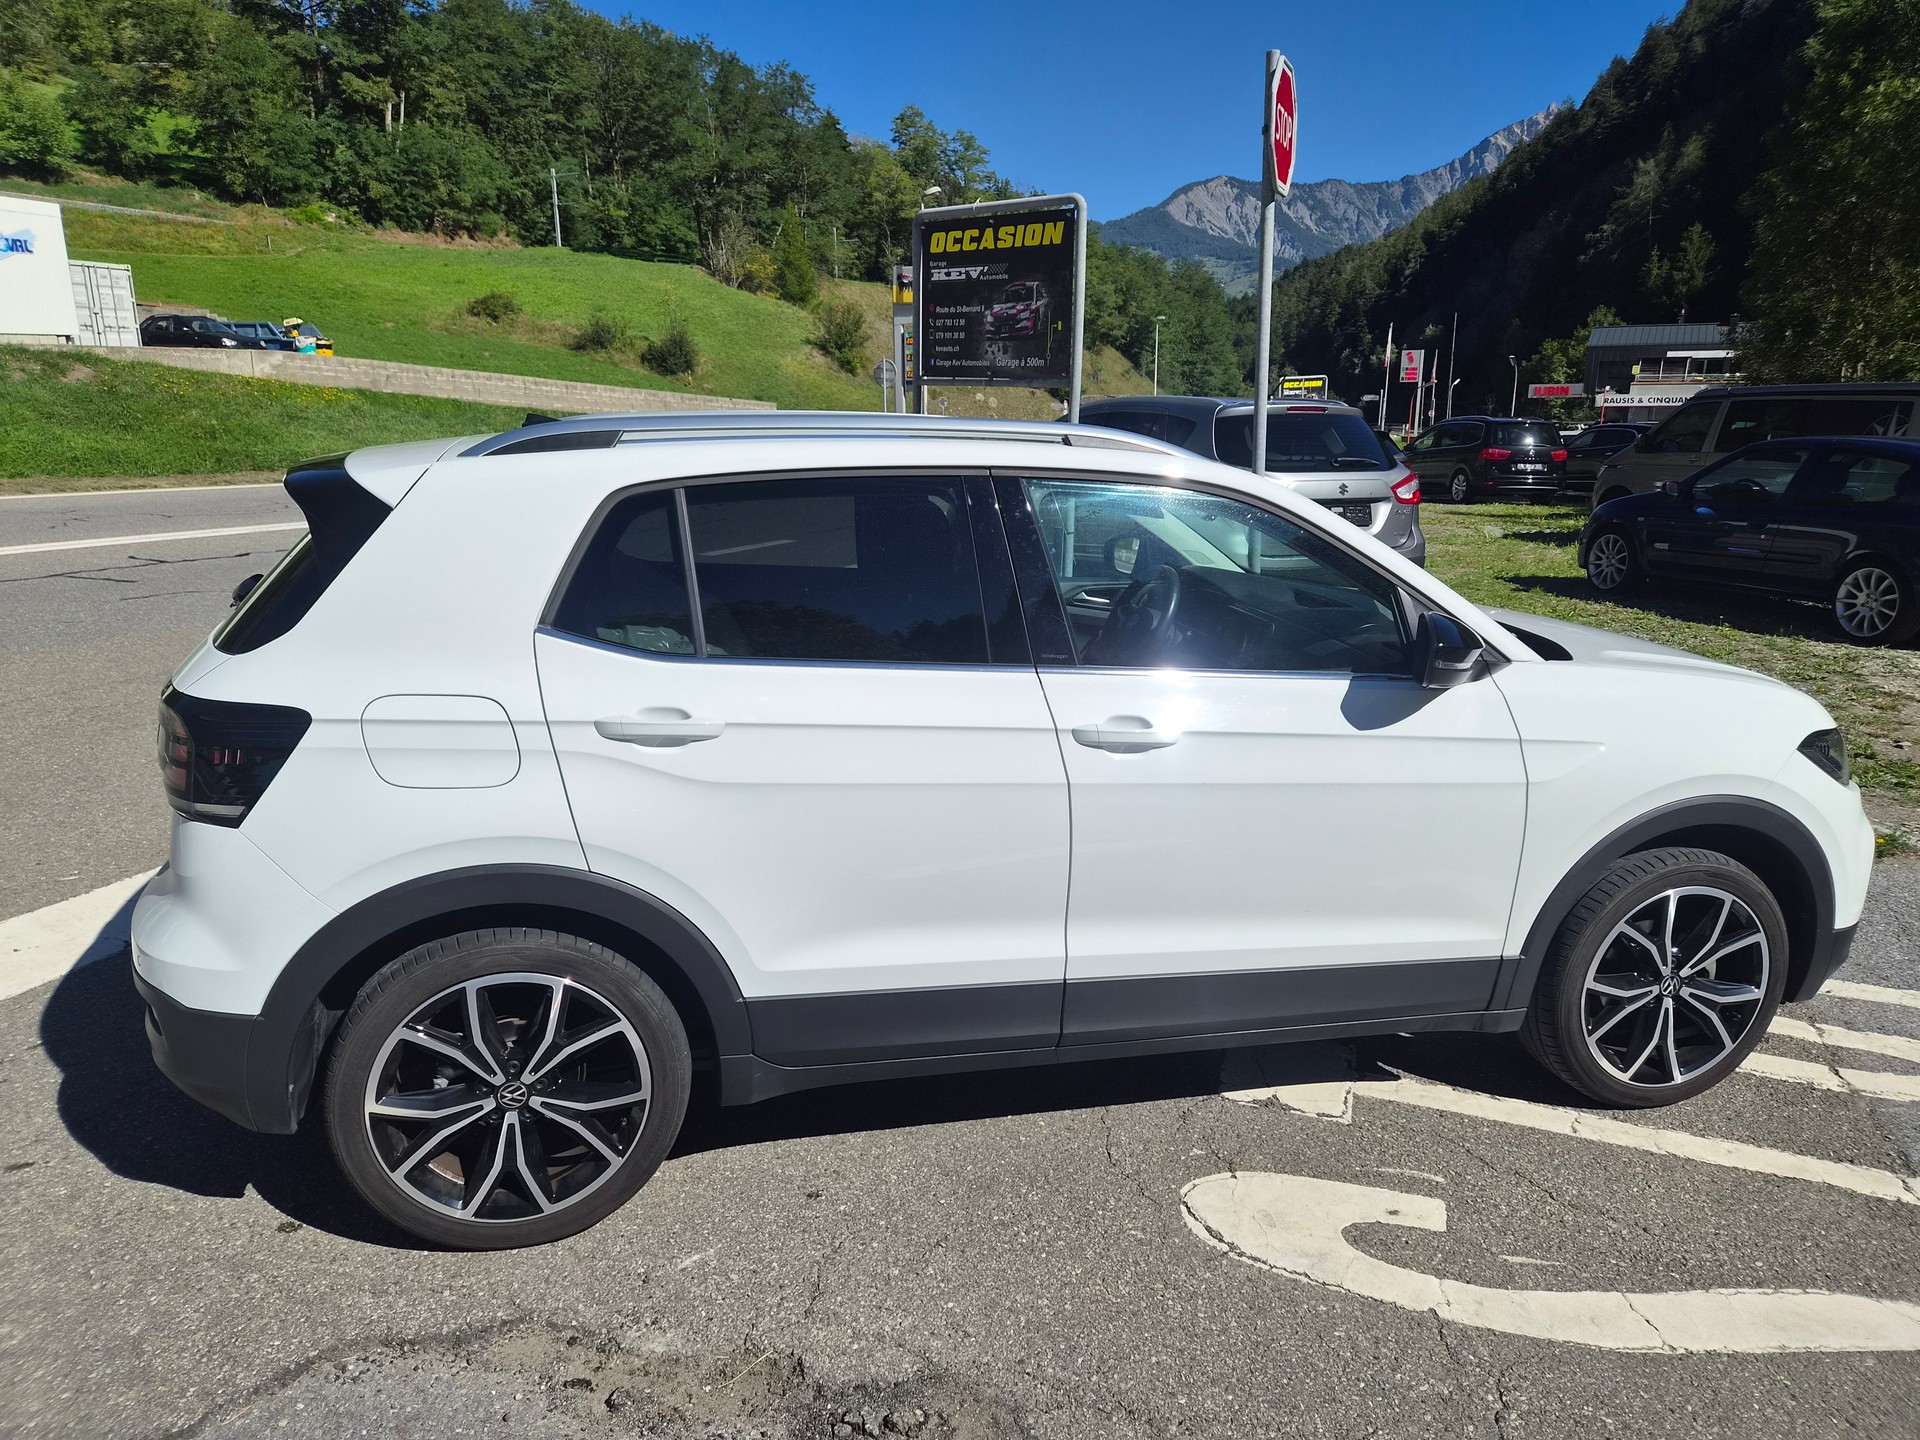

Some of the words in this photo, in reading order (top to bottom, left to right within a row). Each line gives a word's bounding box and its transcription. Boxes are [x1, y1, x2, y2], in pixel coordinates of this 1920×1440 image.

[1276, 102, 1292, 151] STOP
[929, 221, 1065, 254] OCCASION
[956, 304, 981, 313] St-Bernard
[935, 359, 952, 367] Garage
[996, 357, 1020, 368] Garage
[1026, 357, 1045, 367] 500m
